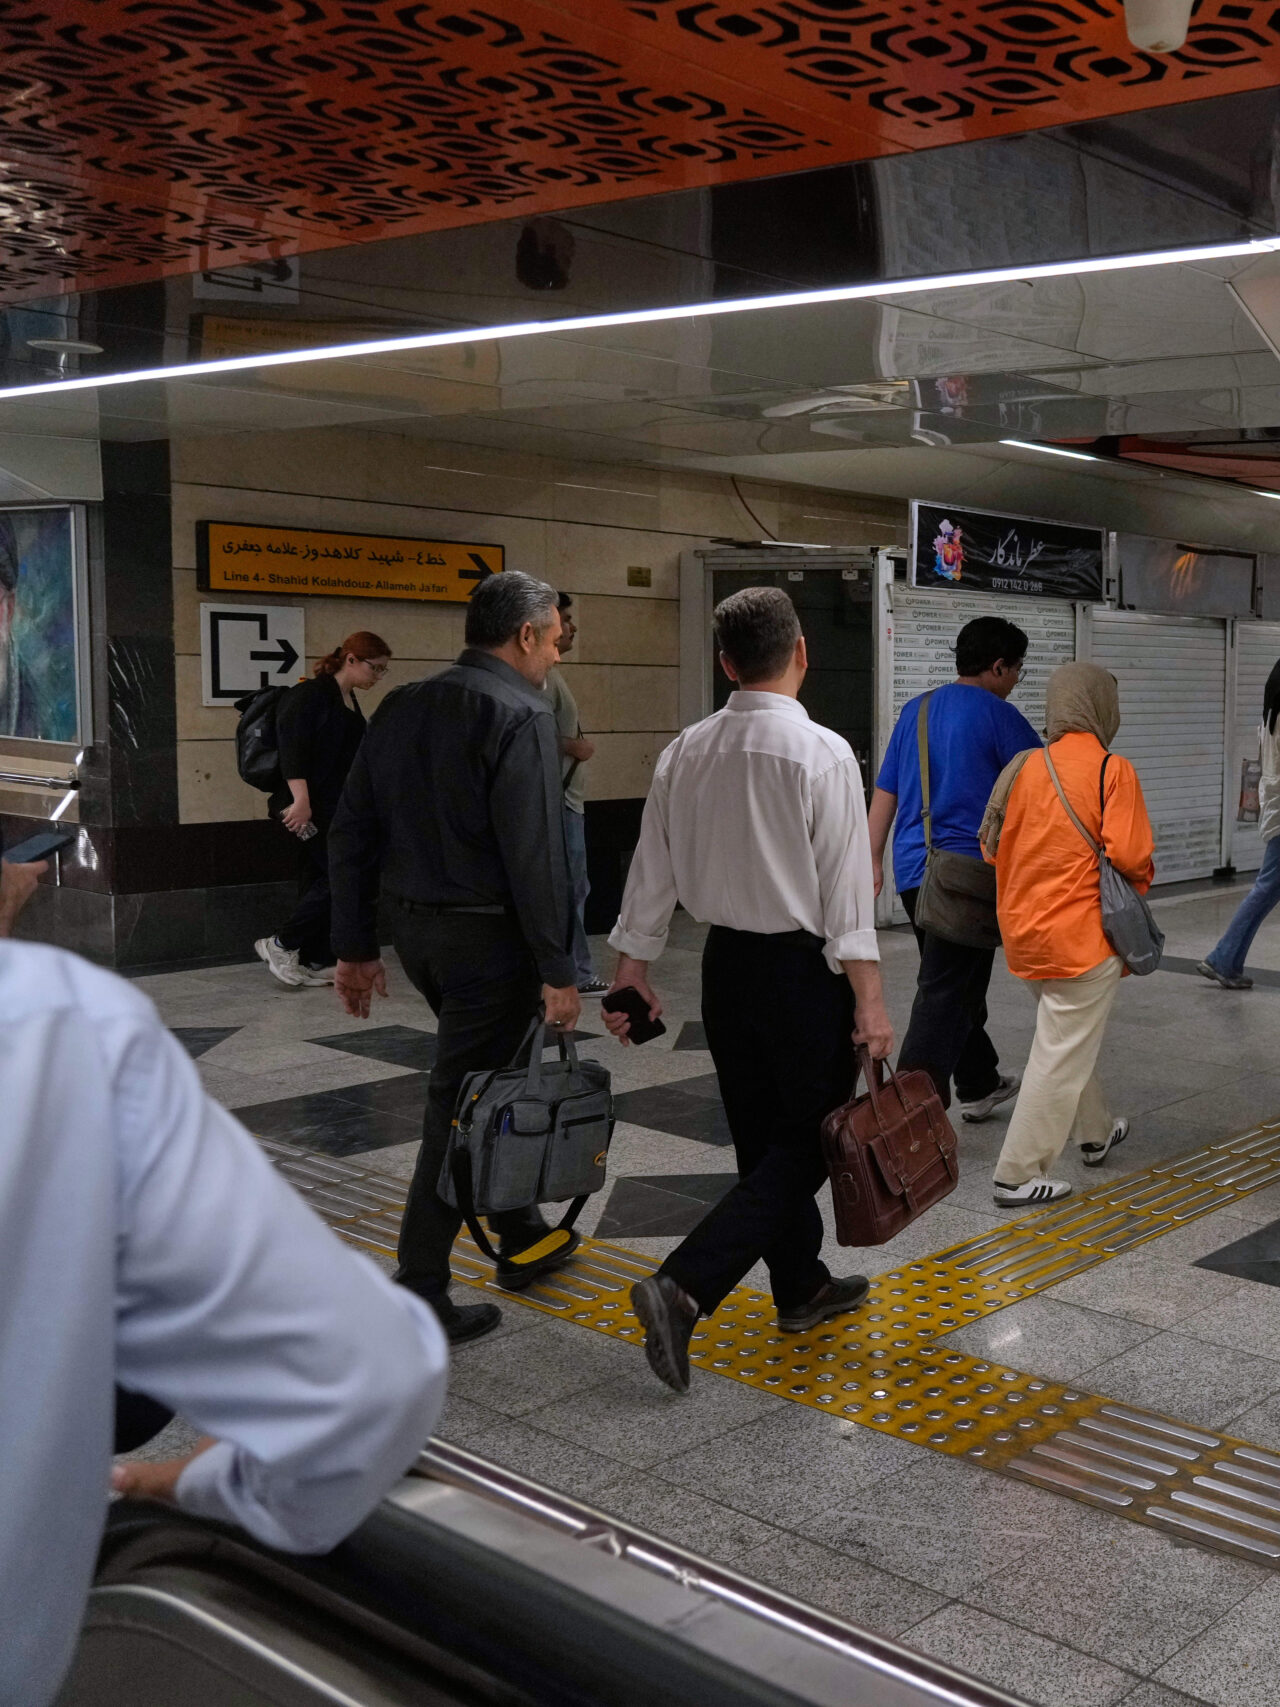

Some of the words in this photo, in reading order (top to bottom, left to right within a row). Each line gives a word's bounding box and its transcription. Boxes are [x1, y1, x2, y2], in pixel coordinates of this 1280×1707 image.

[222, 539, 263, 557] جعفری
[988, 528, 1022, 567] ماندگار
[367, 550, 405, 566] شهید
[1018, 537, 1047, 576] عطر
[223, 570, 250, 582] Line
[268, 573, 309, 586] Shahid
[992, 577, 1008, 589] 0912
[1009, 578, 1022, 590] 142
